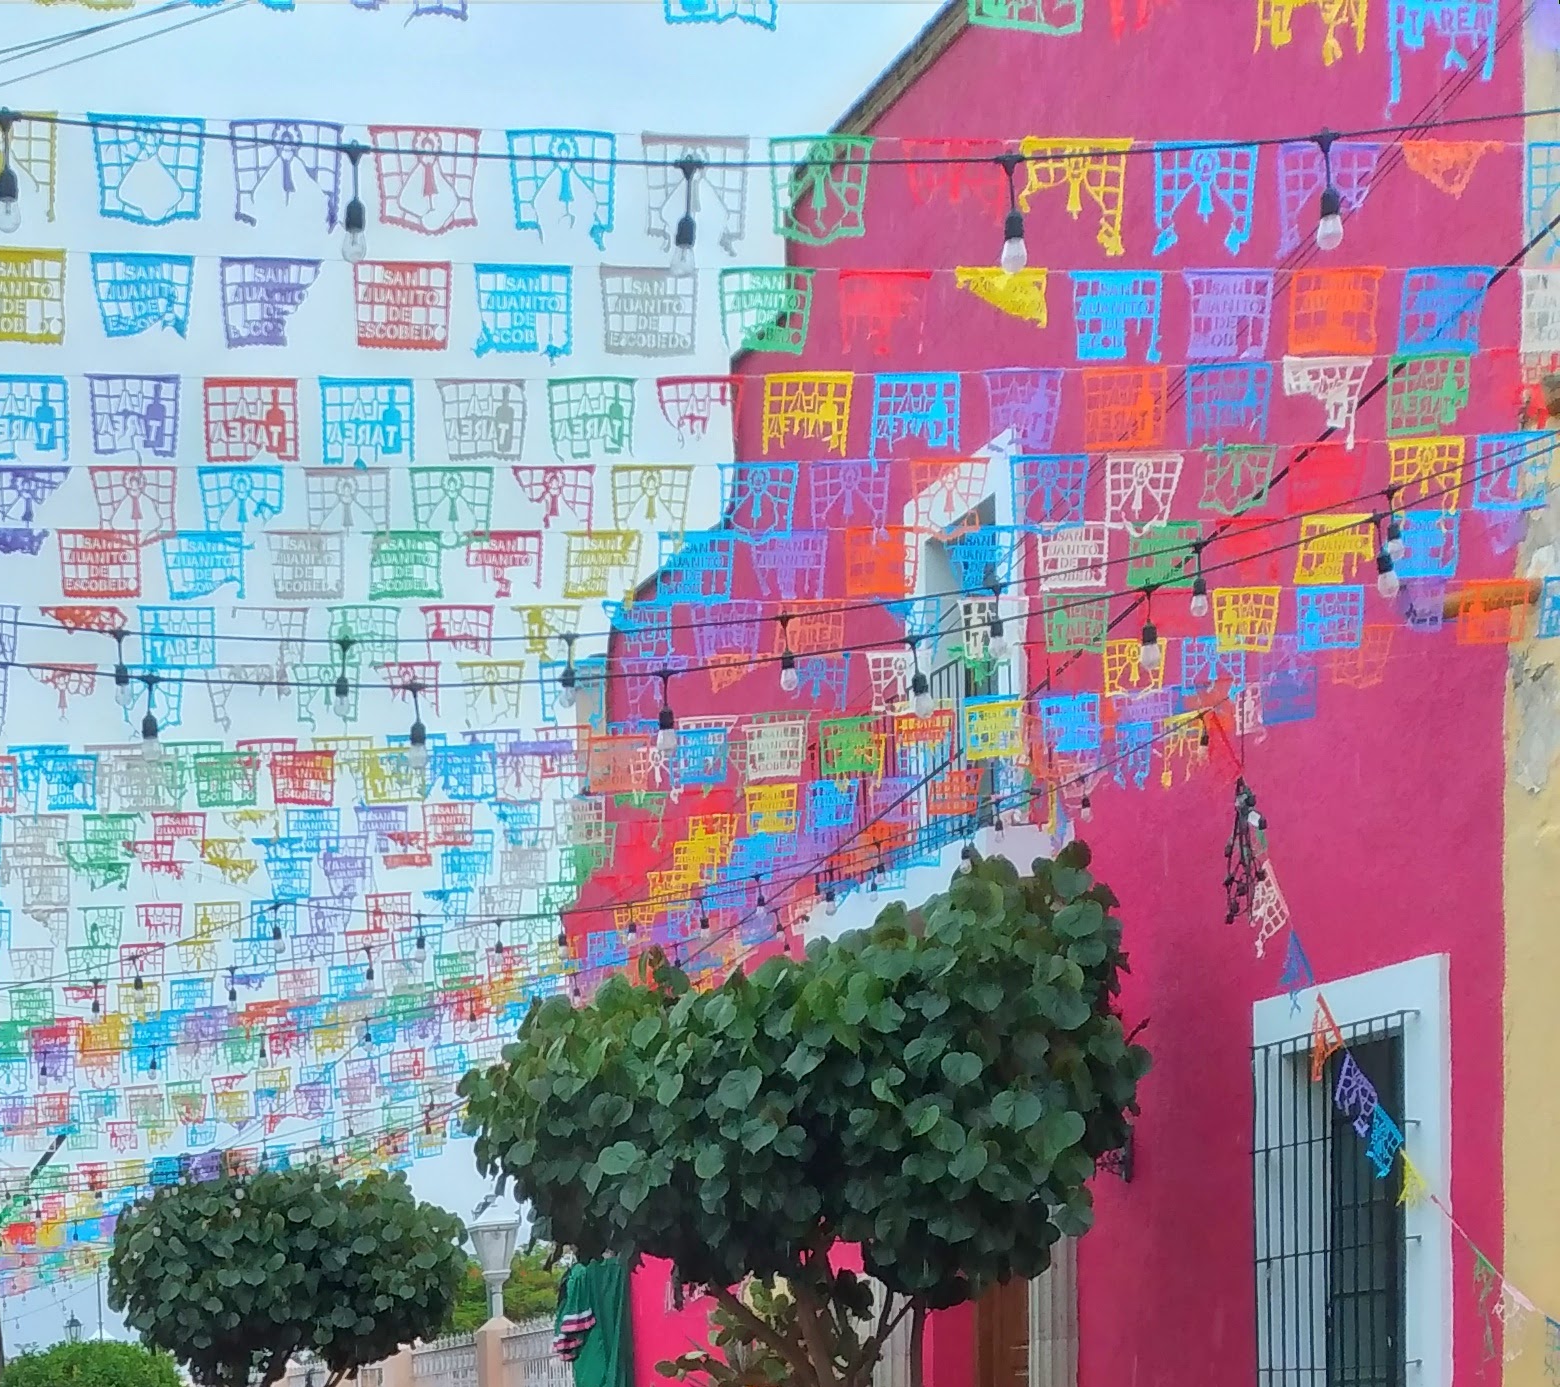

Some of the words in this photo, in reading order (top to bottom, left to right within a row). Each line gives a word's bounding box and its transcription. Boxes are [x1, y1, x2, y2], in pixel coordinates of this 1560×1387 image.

[124, 265, 163, 280] SAN
[255, 268, 289, 283] SAN
[382, 270, 420, 285] SAN
[505, 278, 540, 292] SAN
[632, 281, 667, 296] SAN
[750, 276, 786, 290] SAN
[359, 290, 440, 306] JUANITO
[485, 296, 561, 312] JUANITO
[2, 299, 25, 314] DE
[392, 307, 411, 321] DE
[614, 299, 686, 314] JUANITO
[512, 313, 534, 327] DE
[639, 317, 659, 329] DE
[358, 323, 446, 340] ESCOBEDO
[609, 332, 690, 348] ESCOBEDO
